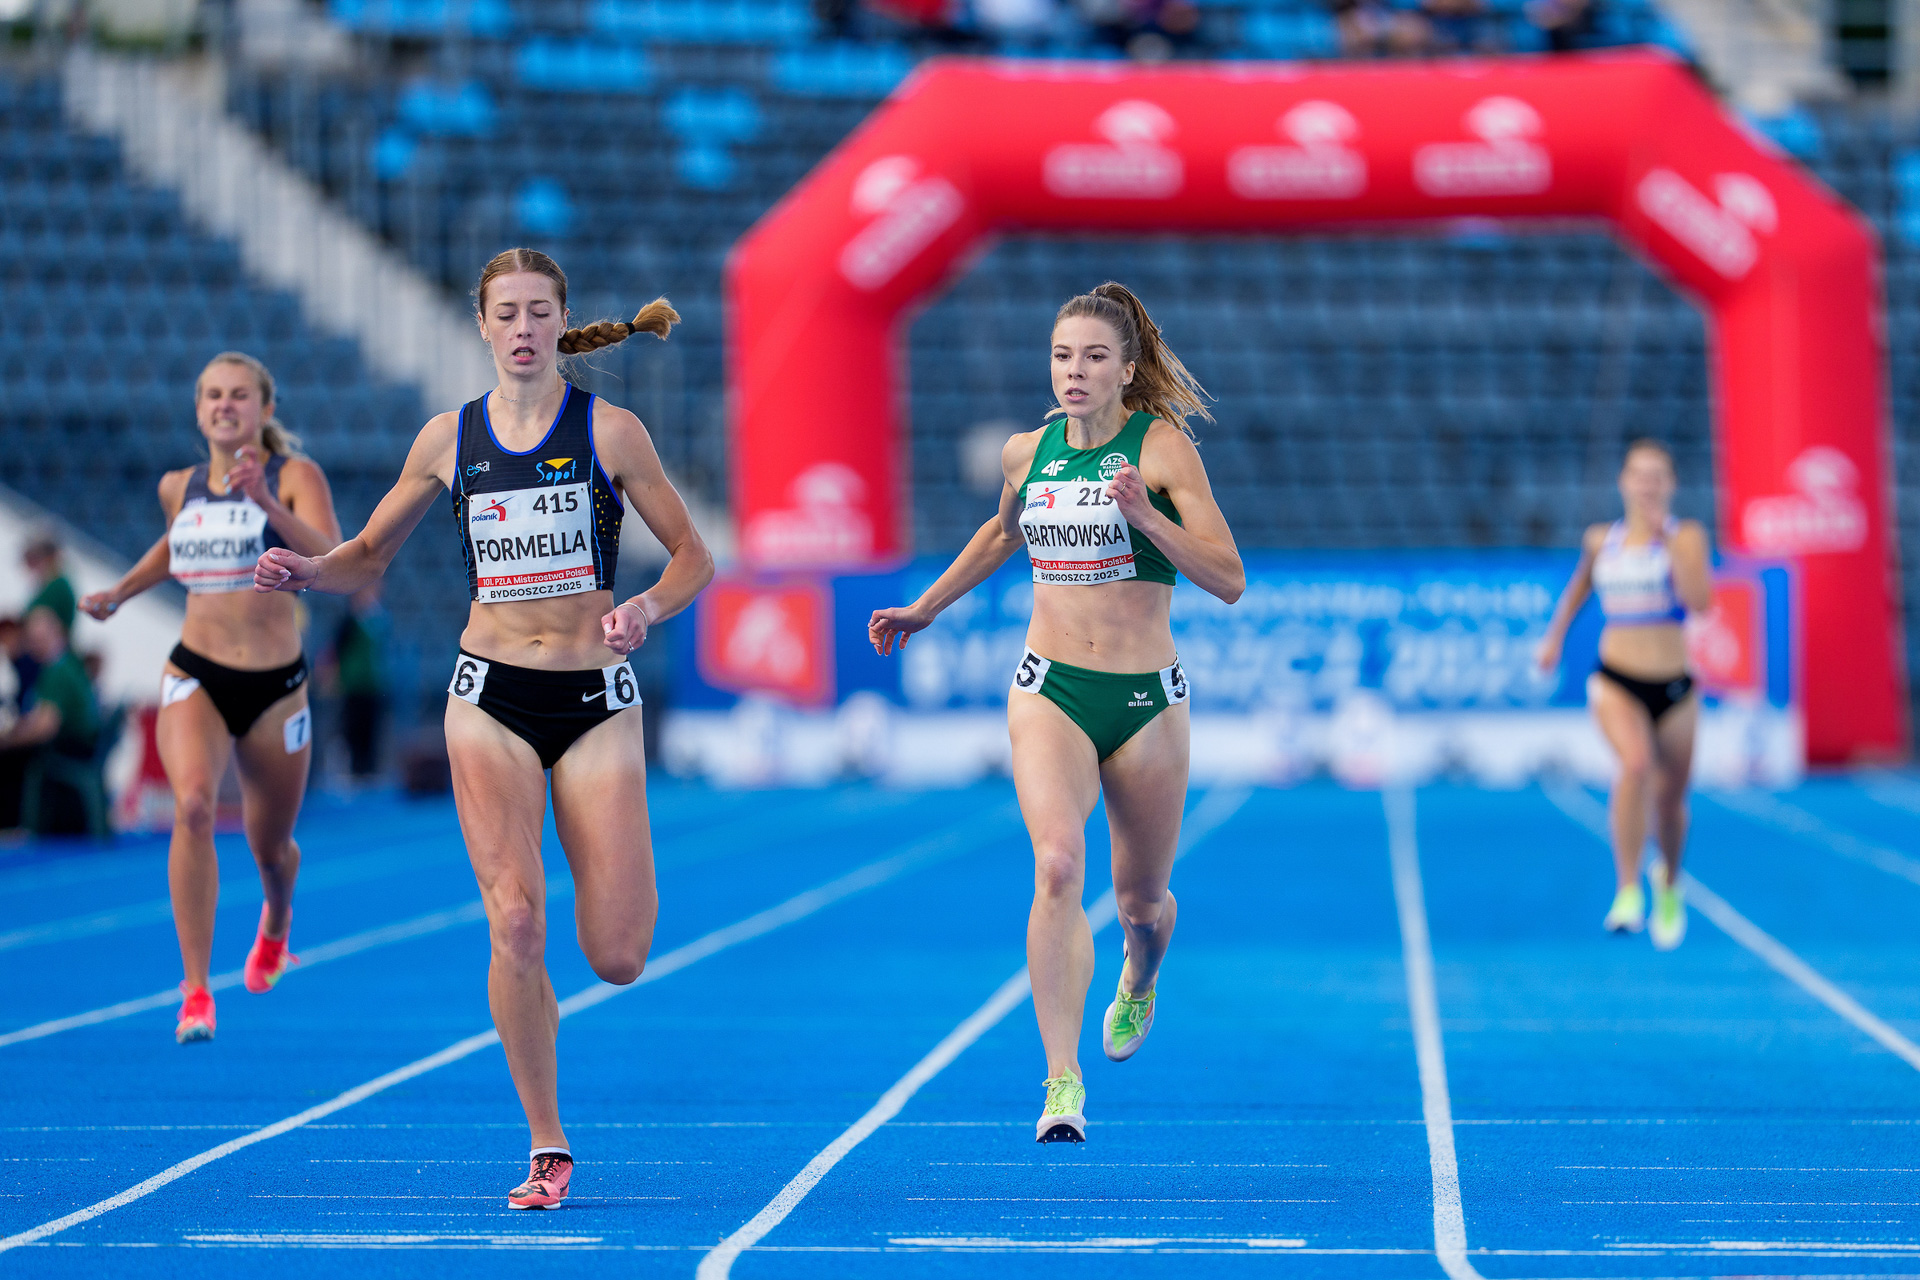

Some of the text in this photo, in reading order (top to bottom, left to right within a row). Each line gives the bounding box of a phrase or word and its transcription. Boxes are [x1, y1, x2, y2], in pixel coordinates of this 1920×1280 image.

[536, 459, 577, 486] Sopot
[1041, 460, 1068, 476] 4F
[532, 491, 579, 515] 415
[229, 508, 248, 523] 11
[471, 512, 498, 523] polanik
[475, 529, 588, 563] FORMELLA
[1023, 523, 1126, 547] BARTNOWSKA
[173, 536, 259, 561] KORCZUK
[1058, 561, 1101, 570] Mistrzostwa
[1102, 556, 1127, 567] Polski
[494, 577, 512, 585] PZLA
[513, 572, 564, 584] Mistrzostwa
[565, 567, 589, 578] Polski
[1041, 569, 1120, 582] BYDGOSZCZ 2025
[490, 580, 582, 599] BYDGOSZCZ 2025
[454, 660, 478, 696] 6
[1016, 652, 1041, 687] 5
[1171, 664, 1187, 698] 5
[614, 666, 635, 704] 6
